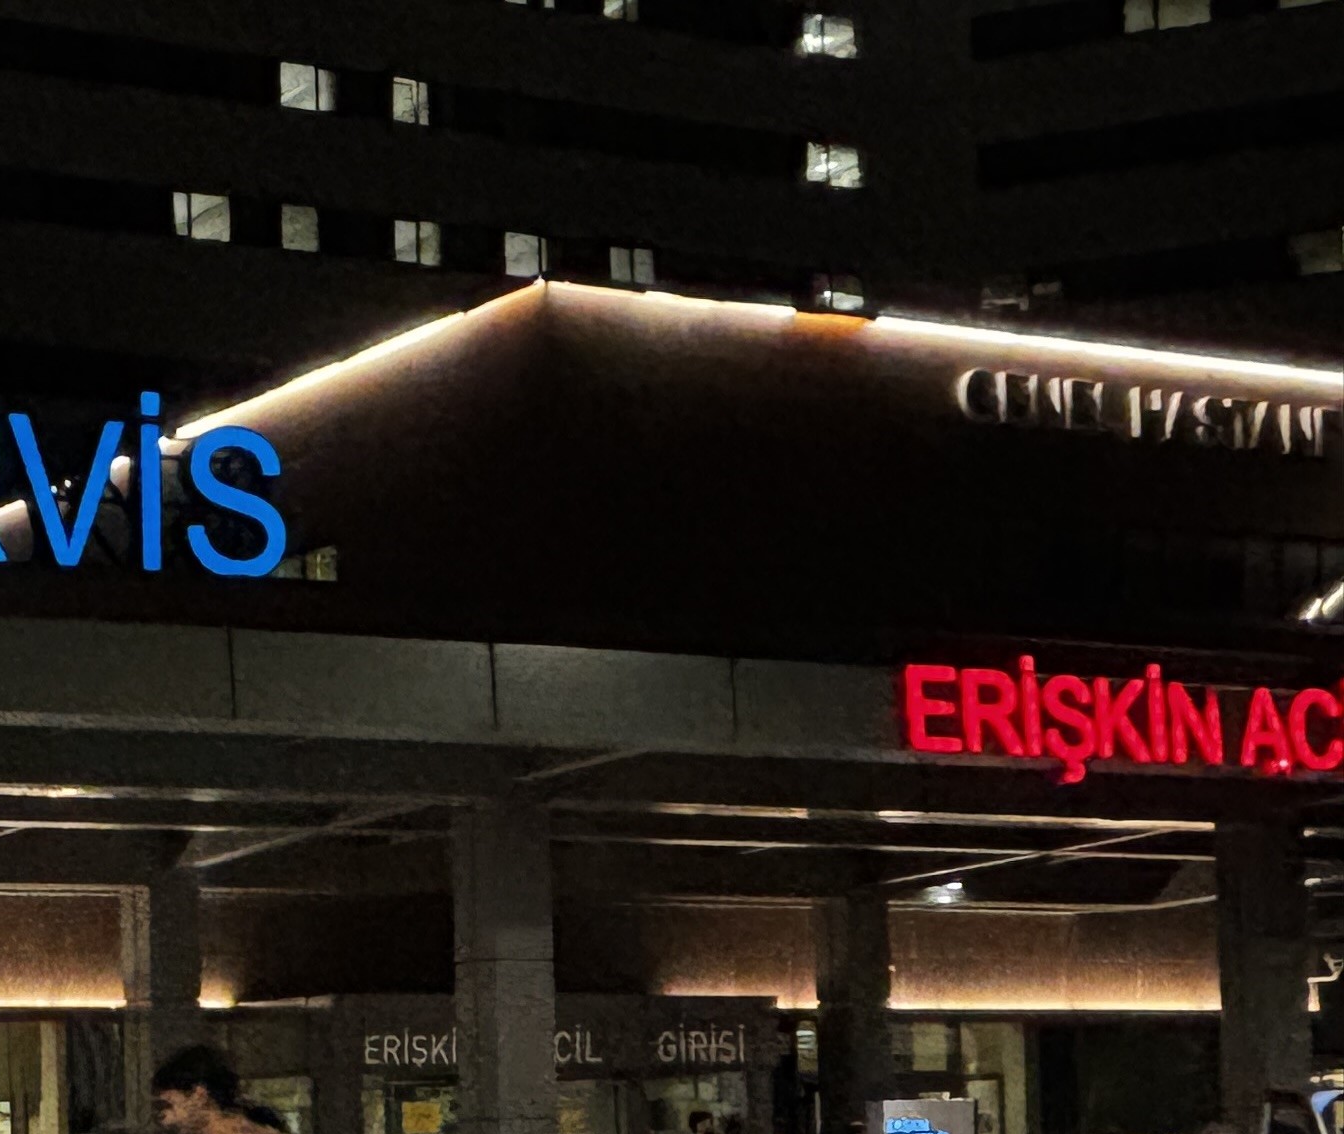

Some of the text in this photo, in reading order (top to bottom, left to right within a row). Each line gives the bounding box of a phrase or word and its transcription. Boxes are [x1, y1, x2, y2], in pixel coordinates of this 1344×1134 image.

[903, 653, 1344, 785] ERİŞKİN AC
[363, 1026, 459, 1068] ERİŞKİ
[552, 1023, 603, 1064] CİL
